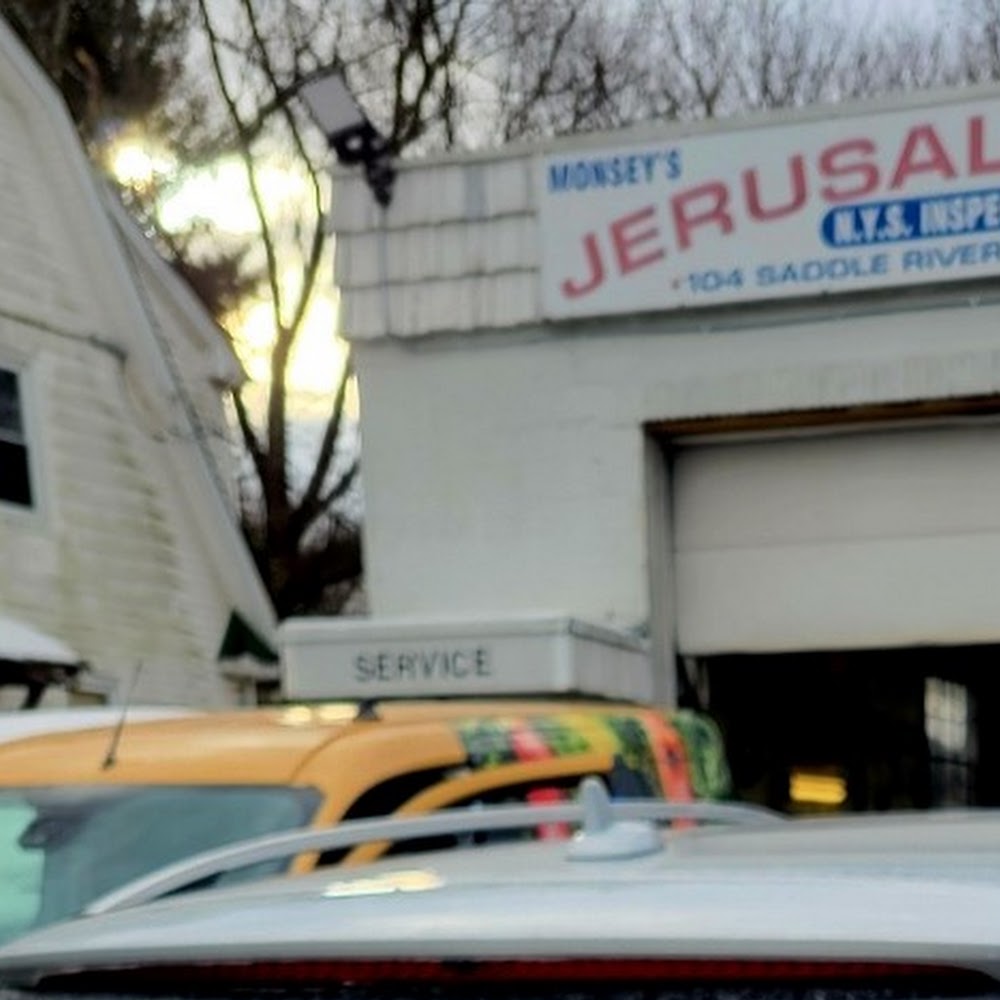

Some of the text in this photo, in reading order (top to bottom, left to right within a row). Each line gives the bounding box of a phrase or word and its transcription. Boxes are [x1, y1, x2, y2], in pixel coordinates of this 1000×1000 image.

[548, 149, 683, 193] MONSEY'S
[831, 204, 914, 245] N.Y.S.
[686, 268, 744, 295] 104
[754, 253, 889, 286] SADDLE
[355, 647, 492, 682] SERVICE
